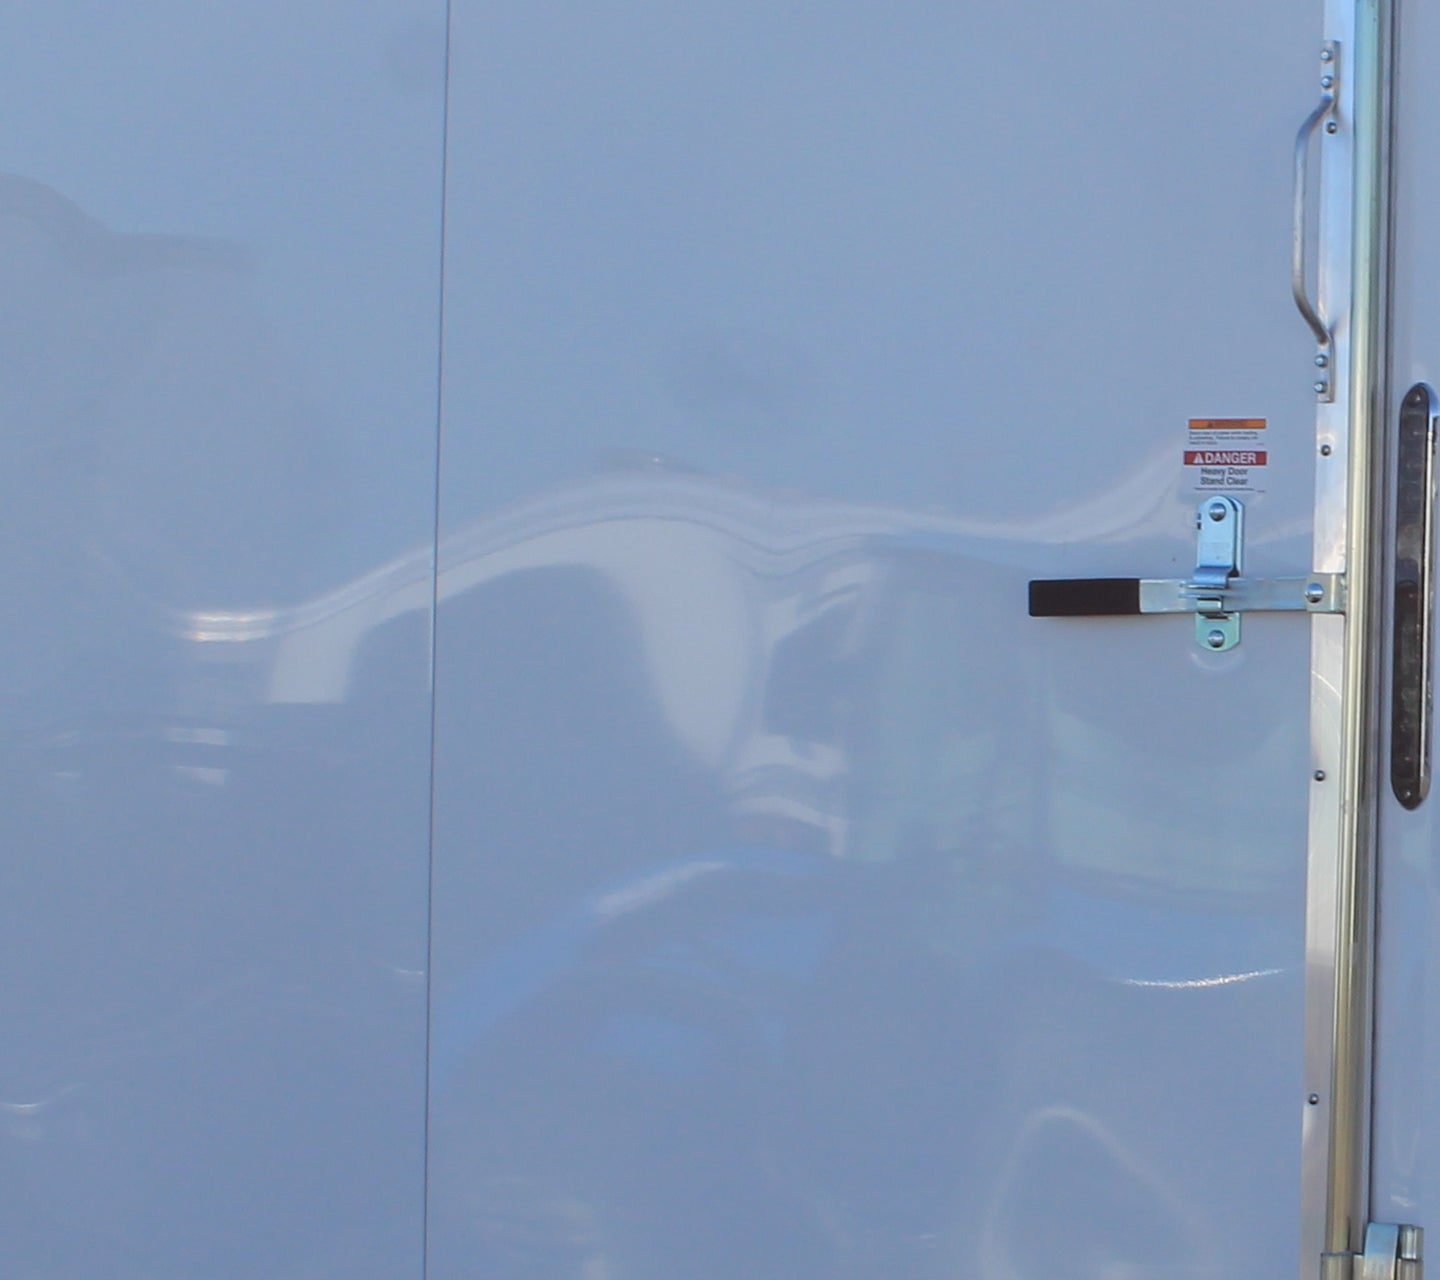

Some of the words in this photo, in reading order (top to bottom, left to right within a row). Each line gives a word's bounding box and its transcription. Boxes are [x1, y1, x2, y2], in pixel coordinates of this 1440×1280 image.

[1205, 452, 1257, 464] DANGER
[1201, 467, 1225, 477] Heavy
[1228, 467, 1248, 475] Door
[1200, 477, 1225, 485] Stand
[1227, 477, 1248, 485] Clear
